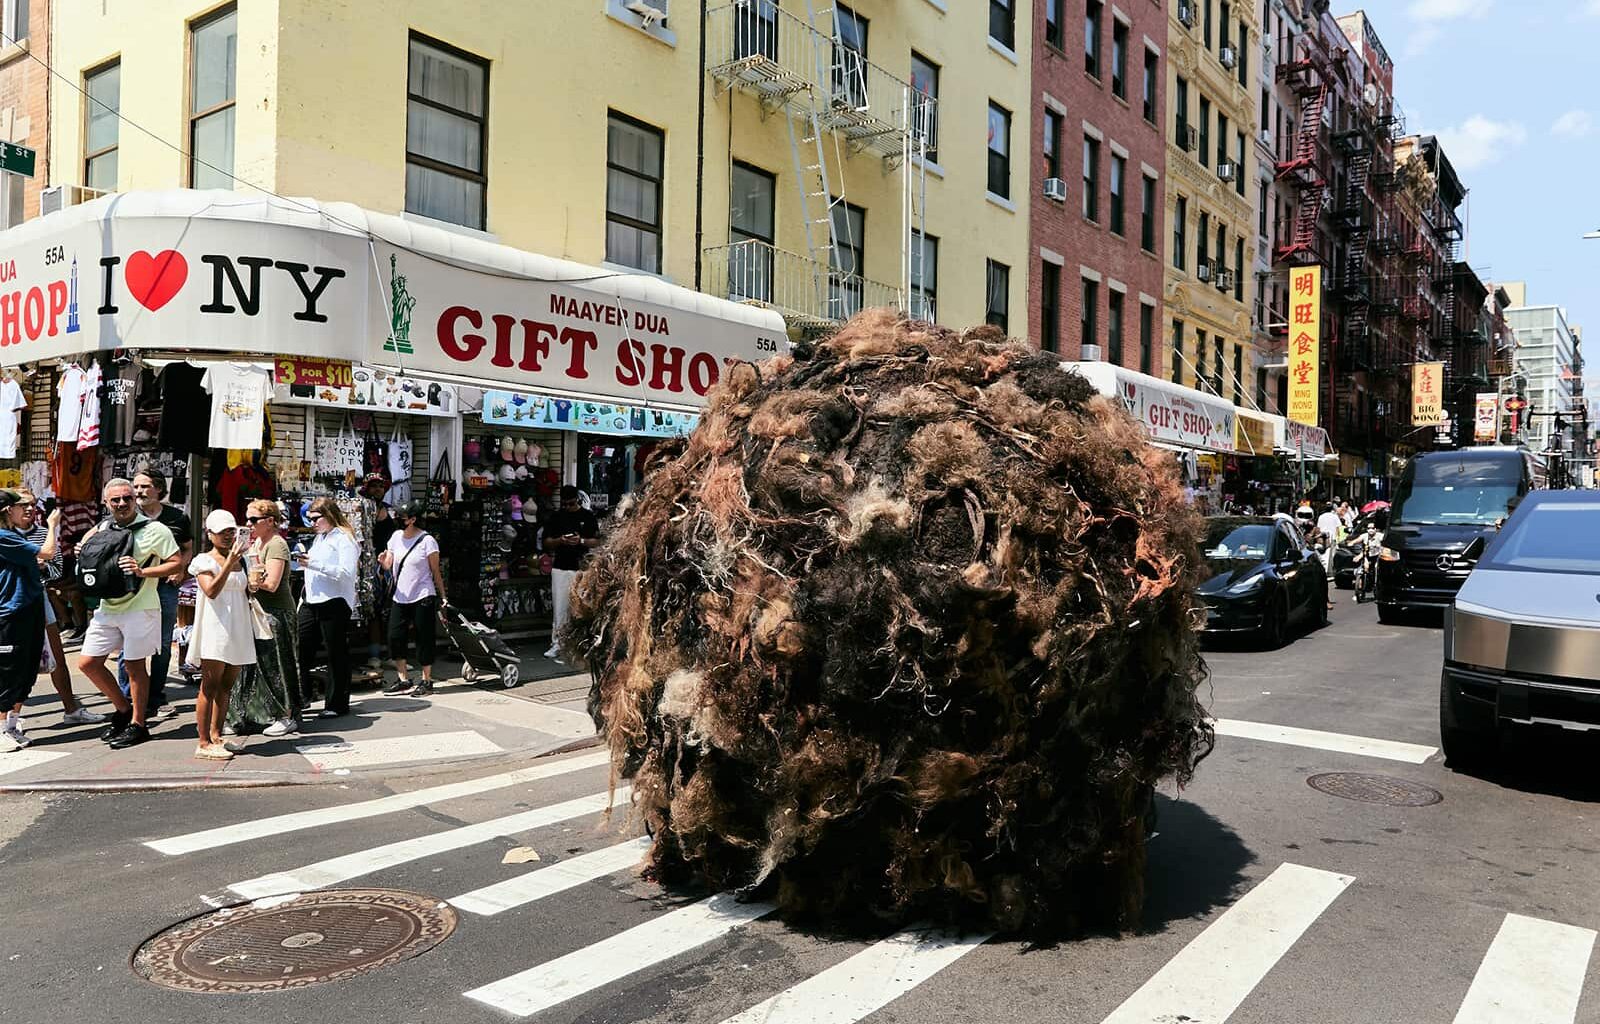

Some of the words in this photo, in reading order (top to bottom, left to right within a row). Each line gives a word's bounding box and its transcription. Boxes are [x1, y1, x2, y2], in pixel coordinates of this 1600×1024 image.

[16, 148, 28, 158] St
[45, 245, 65, 266] 55A
[97, 256, 121, 315] I
[200, 254, 346, 323] NY
[550, 294, 628, 327] MAAYER
[634, 310, 669, 336] DUA
[1293, 272, 1315, 385] 明旺食堂
[436, 305, 598, 380] GIFT
[616, 338, 729, 397] SHO
[756, 336, 777, 353] 55A
[279, 361, 297, 384] 3
[301, 368, 323, 378] FOR
[326, 365, 352, 385] $10
[1294, 390, 1311, 398] MING
[1292, 400, 1312, 410] WONG
[1418, 405, 1434, 413] BIG
[1150, 404, 1180, 430] GIFT
[1183, 412, 1212, 436] SHOP
[334, 448, 364, 457] ORK
